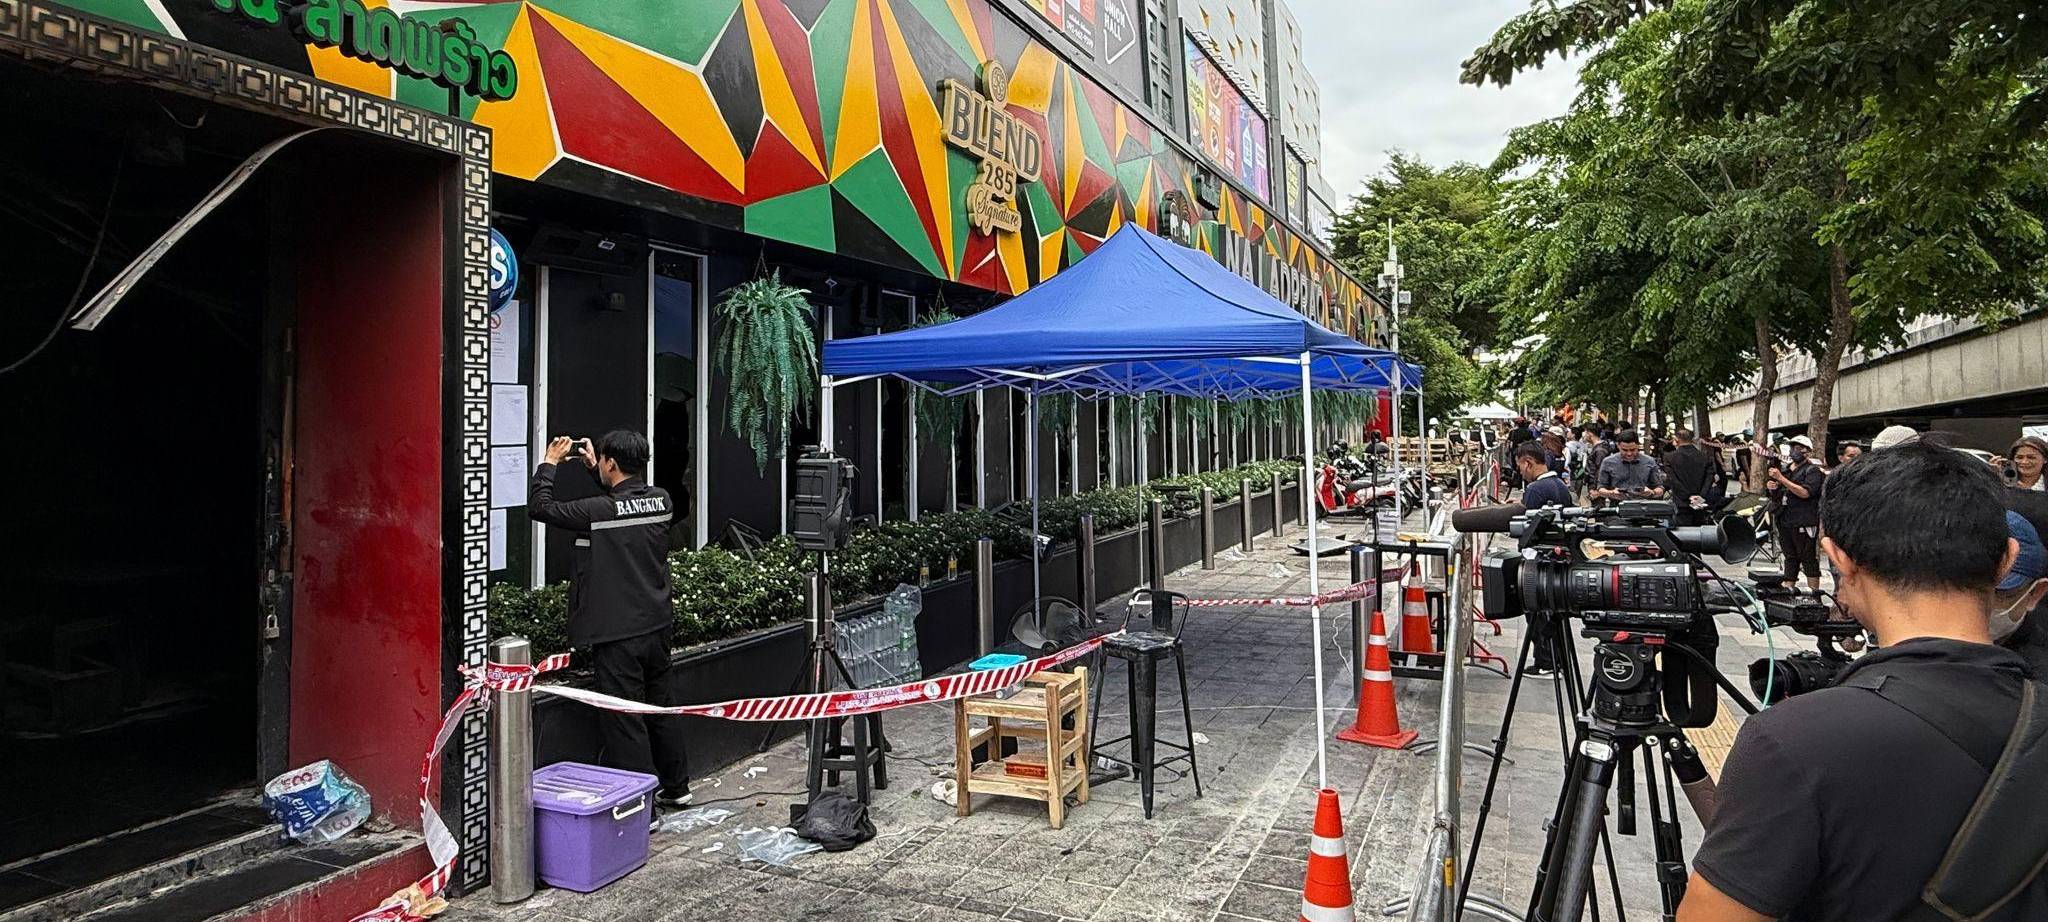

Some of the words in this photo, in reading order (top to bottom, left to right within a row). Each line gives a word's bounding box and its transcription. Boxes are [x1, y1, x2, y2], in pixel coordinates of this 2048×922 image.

[304, 0, 517, 98] ลาดพร้าว
[951, 87, 1040, 175] BLEND
[984, 161, 1014, 195] 285
[975, 188, 1019, 228] Signature
[615, 496, 666, 516] BANGKOK
